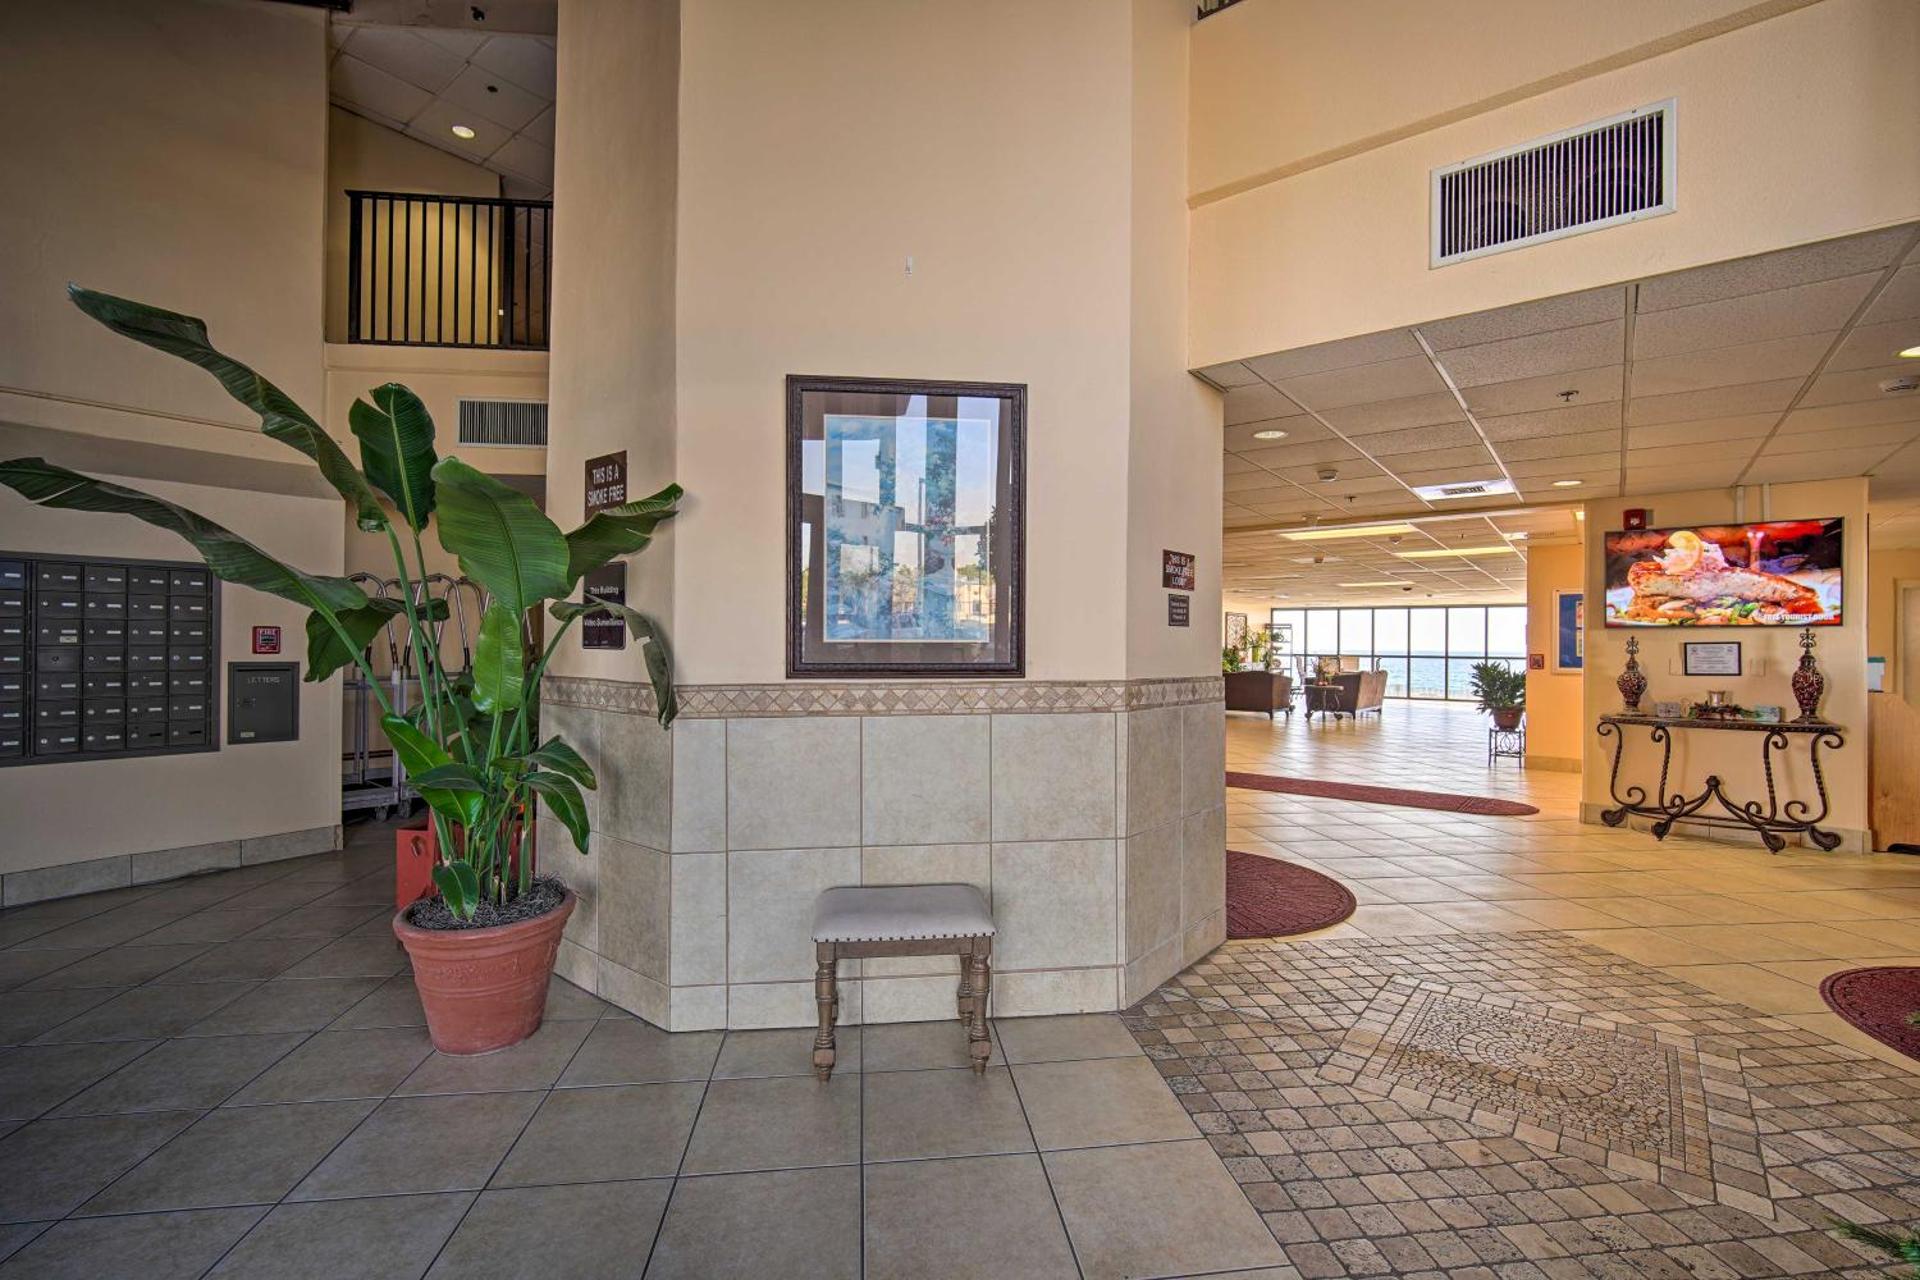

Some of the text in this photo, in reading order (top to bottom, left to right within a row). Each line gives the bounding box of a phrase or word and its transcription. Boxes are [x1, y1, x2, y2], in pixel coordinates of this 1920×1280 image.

[592, 467, 605, 484] THIS
[588, 484, 624, 507] SMOKE FREE
[247, 676, 281, 684] LETTERS
